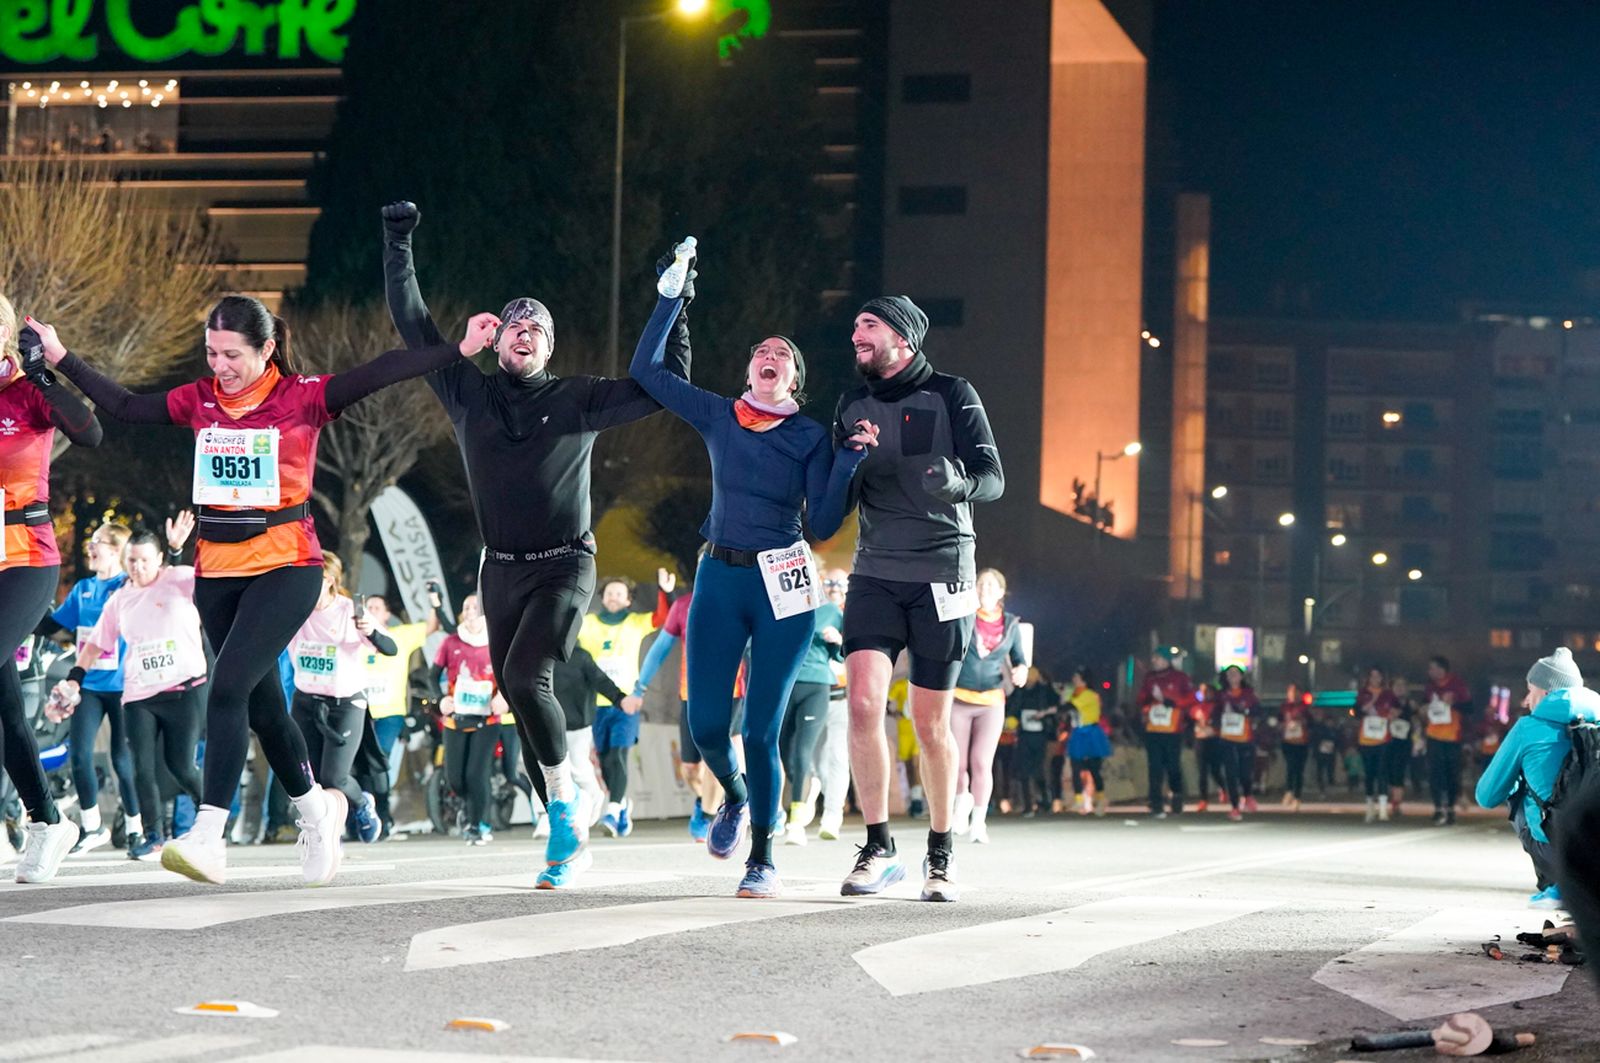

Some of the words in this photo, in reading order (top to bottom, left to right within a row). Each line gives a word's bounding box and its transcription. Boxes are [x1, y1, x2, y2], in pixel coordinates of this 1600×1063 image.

[213, 436, 237, 445] NOCHE
[237, 437, 246, 445] DE
[204, 445, 219, 454] SAN
[211, 455, 261, 480] 9531
[495, 551, 516, 561] TIPICK
[525, 552, 537, 561] GO
[776, 550, 797, 562] NOCHE
[797, 548, 805, 556] DE
[769, 564, 785, 573] SAN
[142, 654, 174, 670] 6623
[300, 656, 333, 671] 12395
